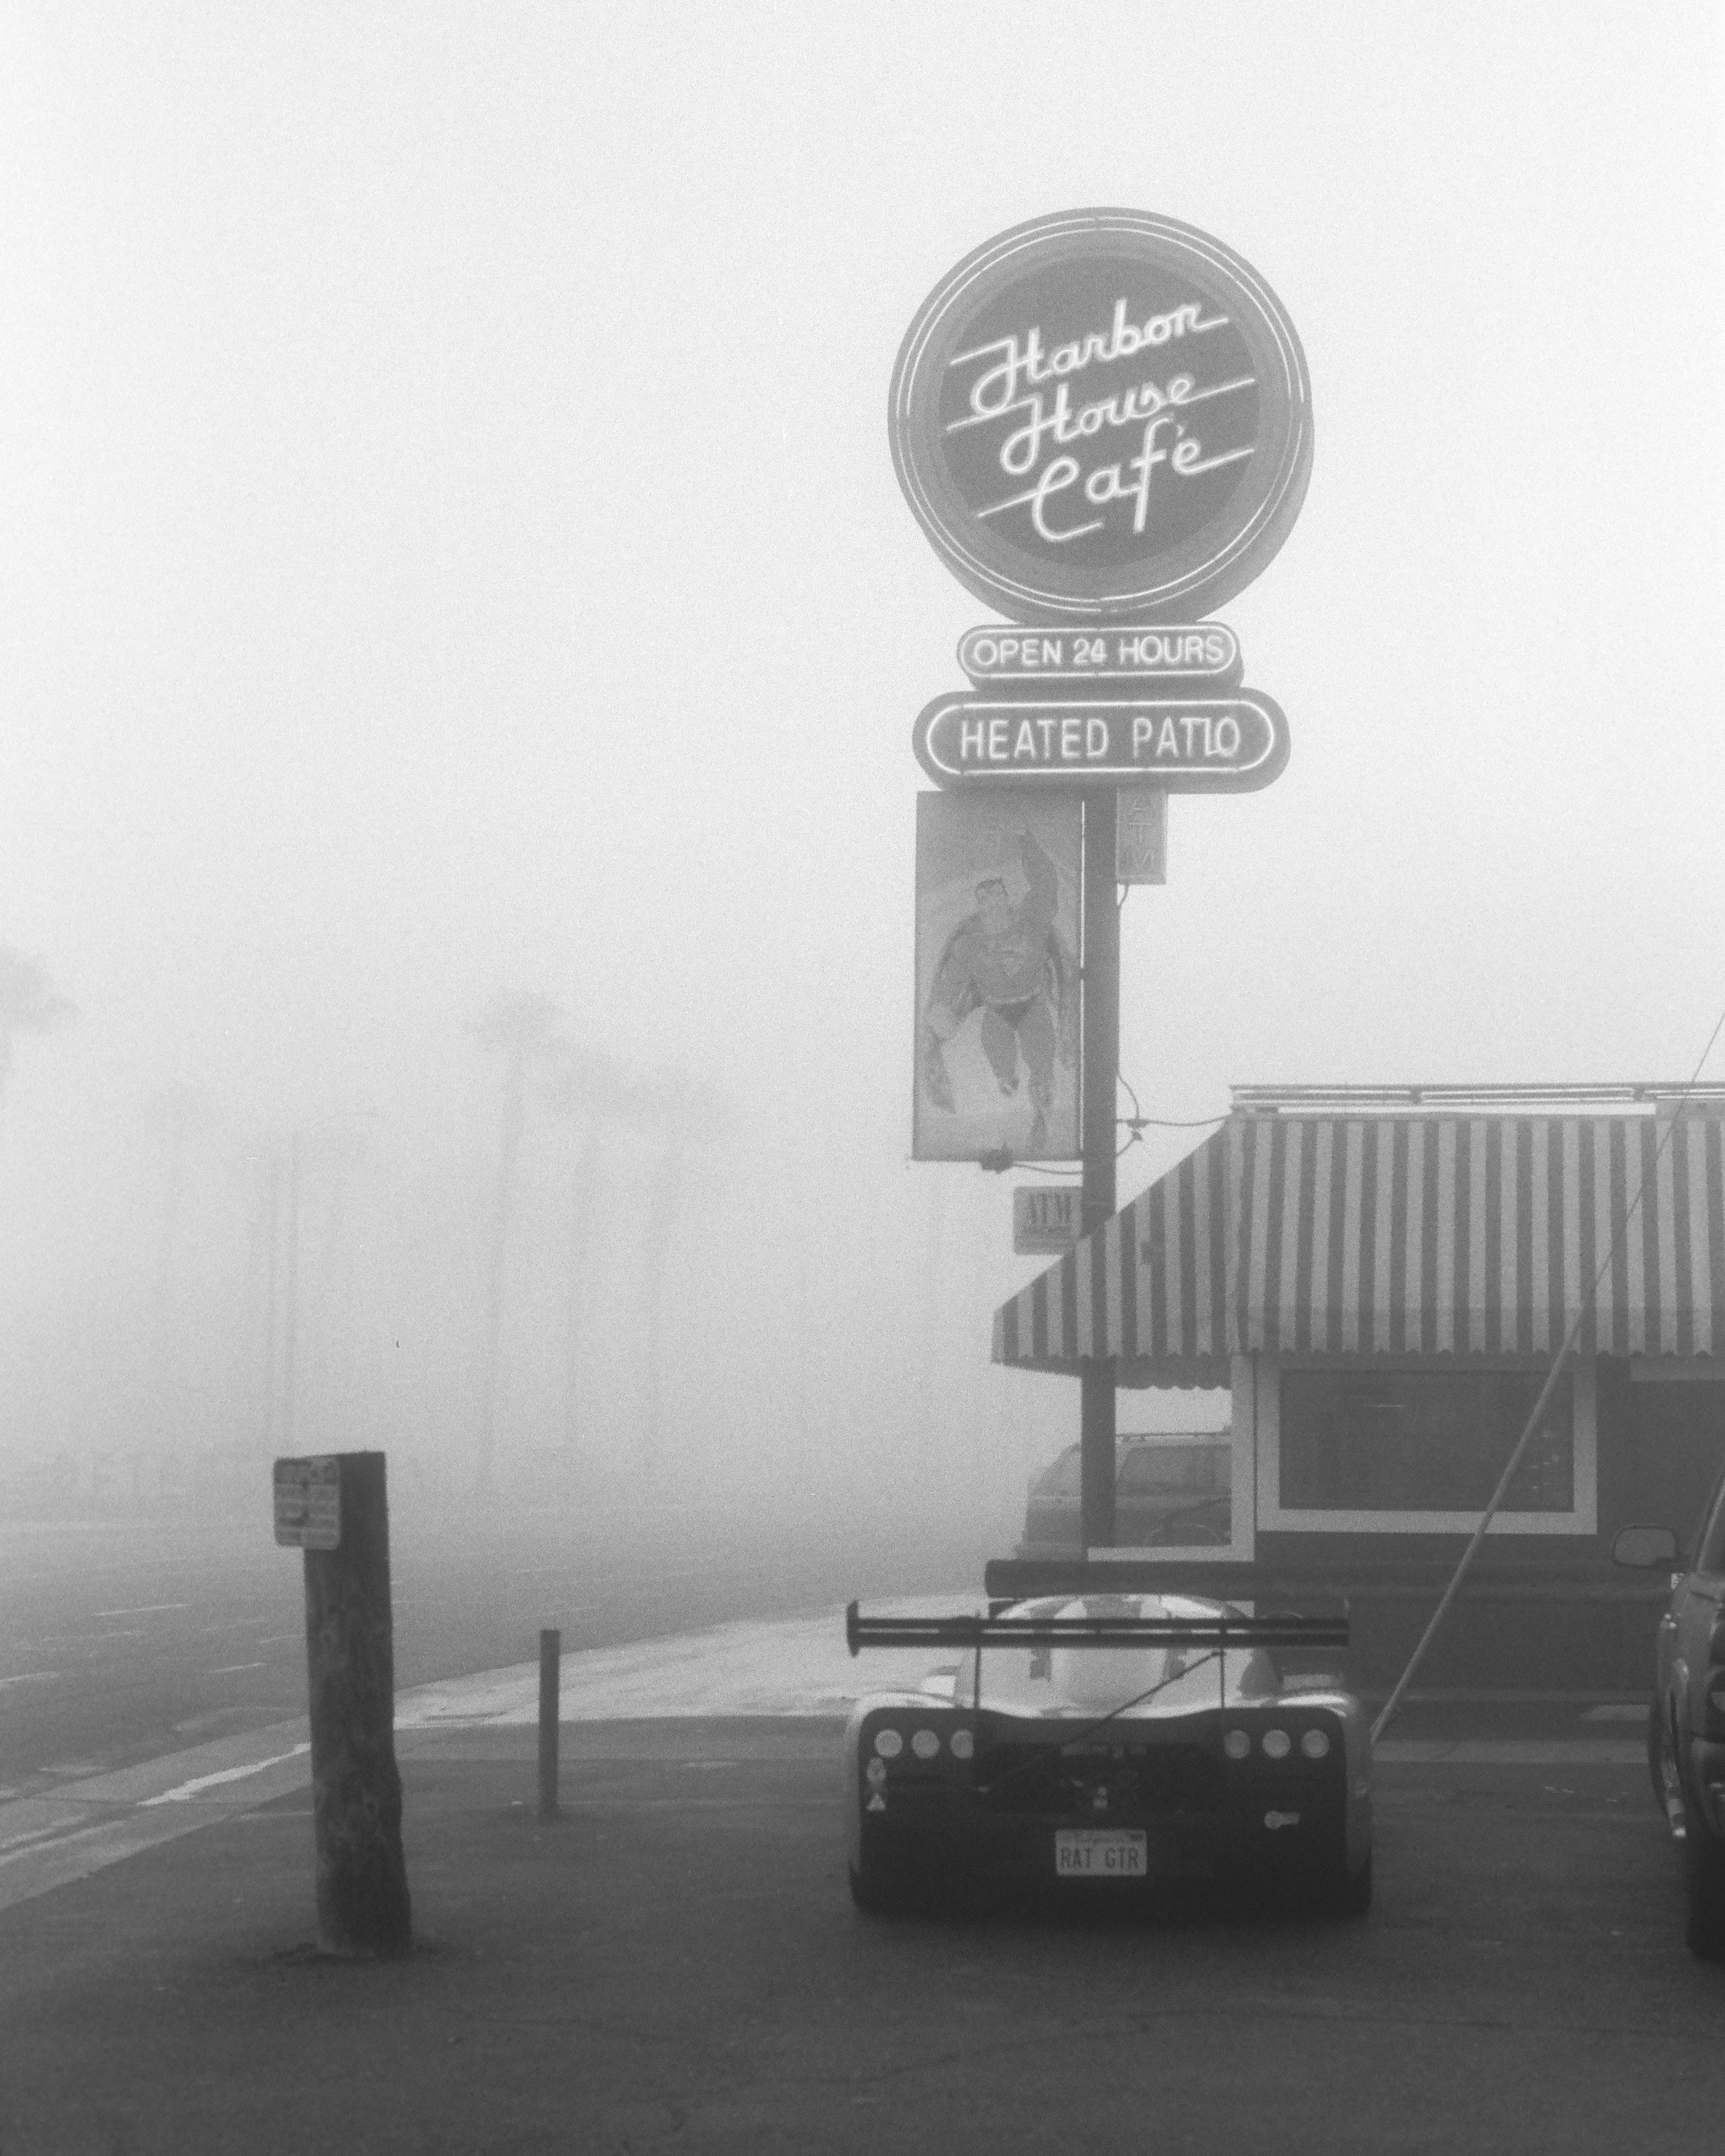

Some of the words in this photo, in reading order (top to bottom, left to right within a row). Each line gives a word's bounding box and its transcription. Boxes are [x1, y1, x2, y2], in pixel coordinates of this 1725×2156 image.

[949, 298, 1230, 415] Harbor
[945, 378, 1256, 475] House
[974, 639, 1062, 665] OPEN
[1073, 638, 1106, 664] 24
[1119, 635, 1224, 664] HOURS
[960, 719, 1109, 759] HEATED
[1132, 716, 1240, 757] PATIO
[1061, 1846, 1092, 1869] RAT
[1105, 1846, 1139, 1869] GTR
